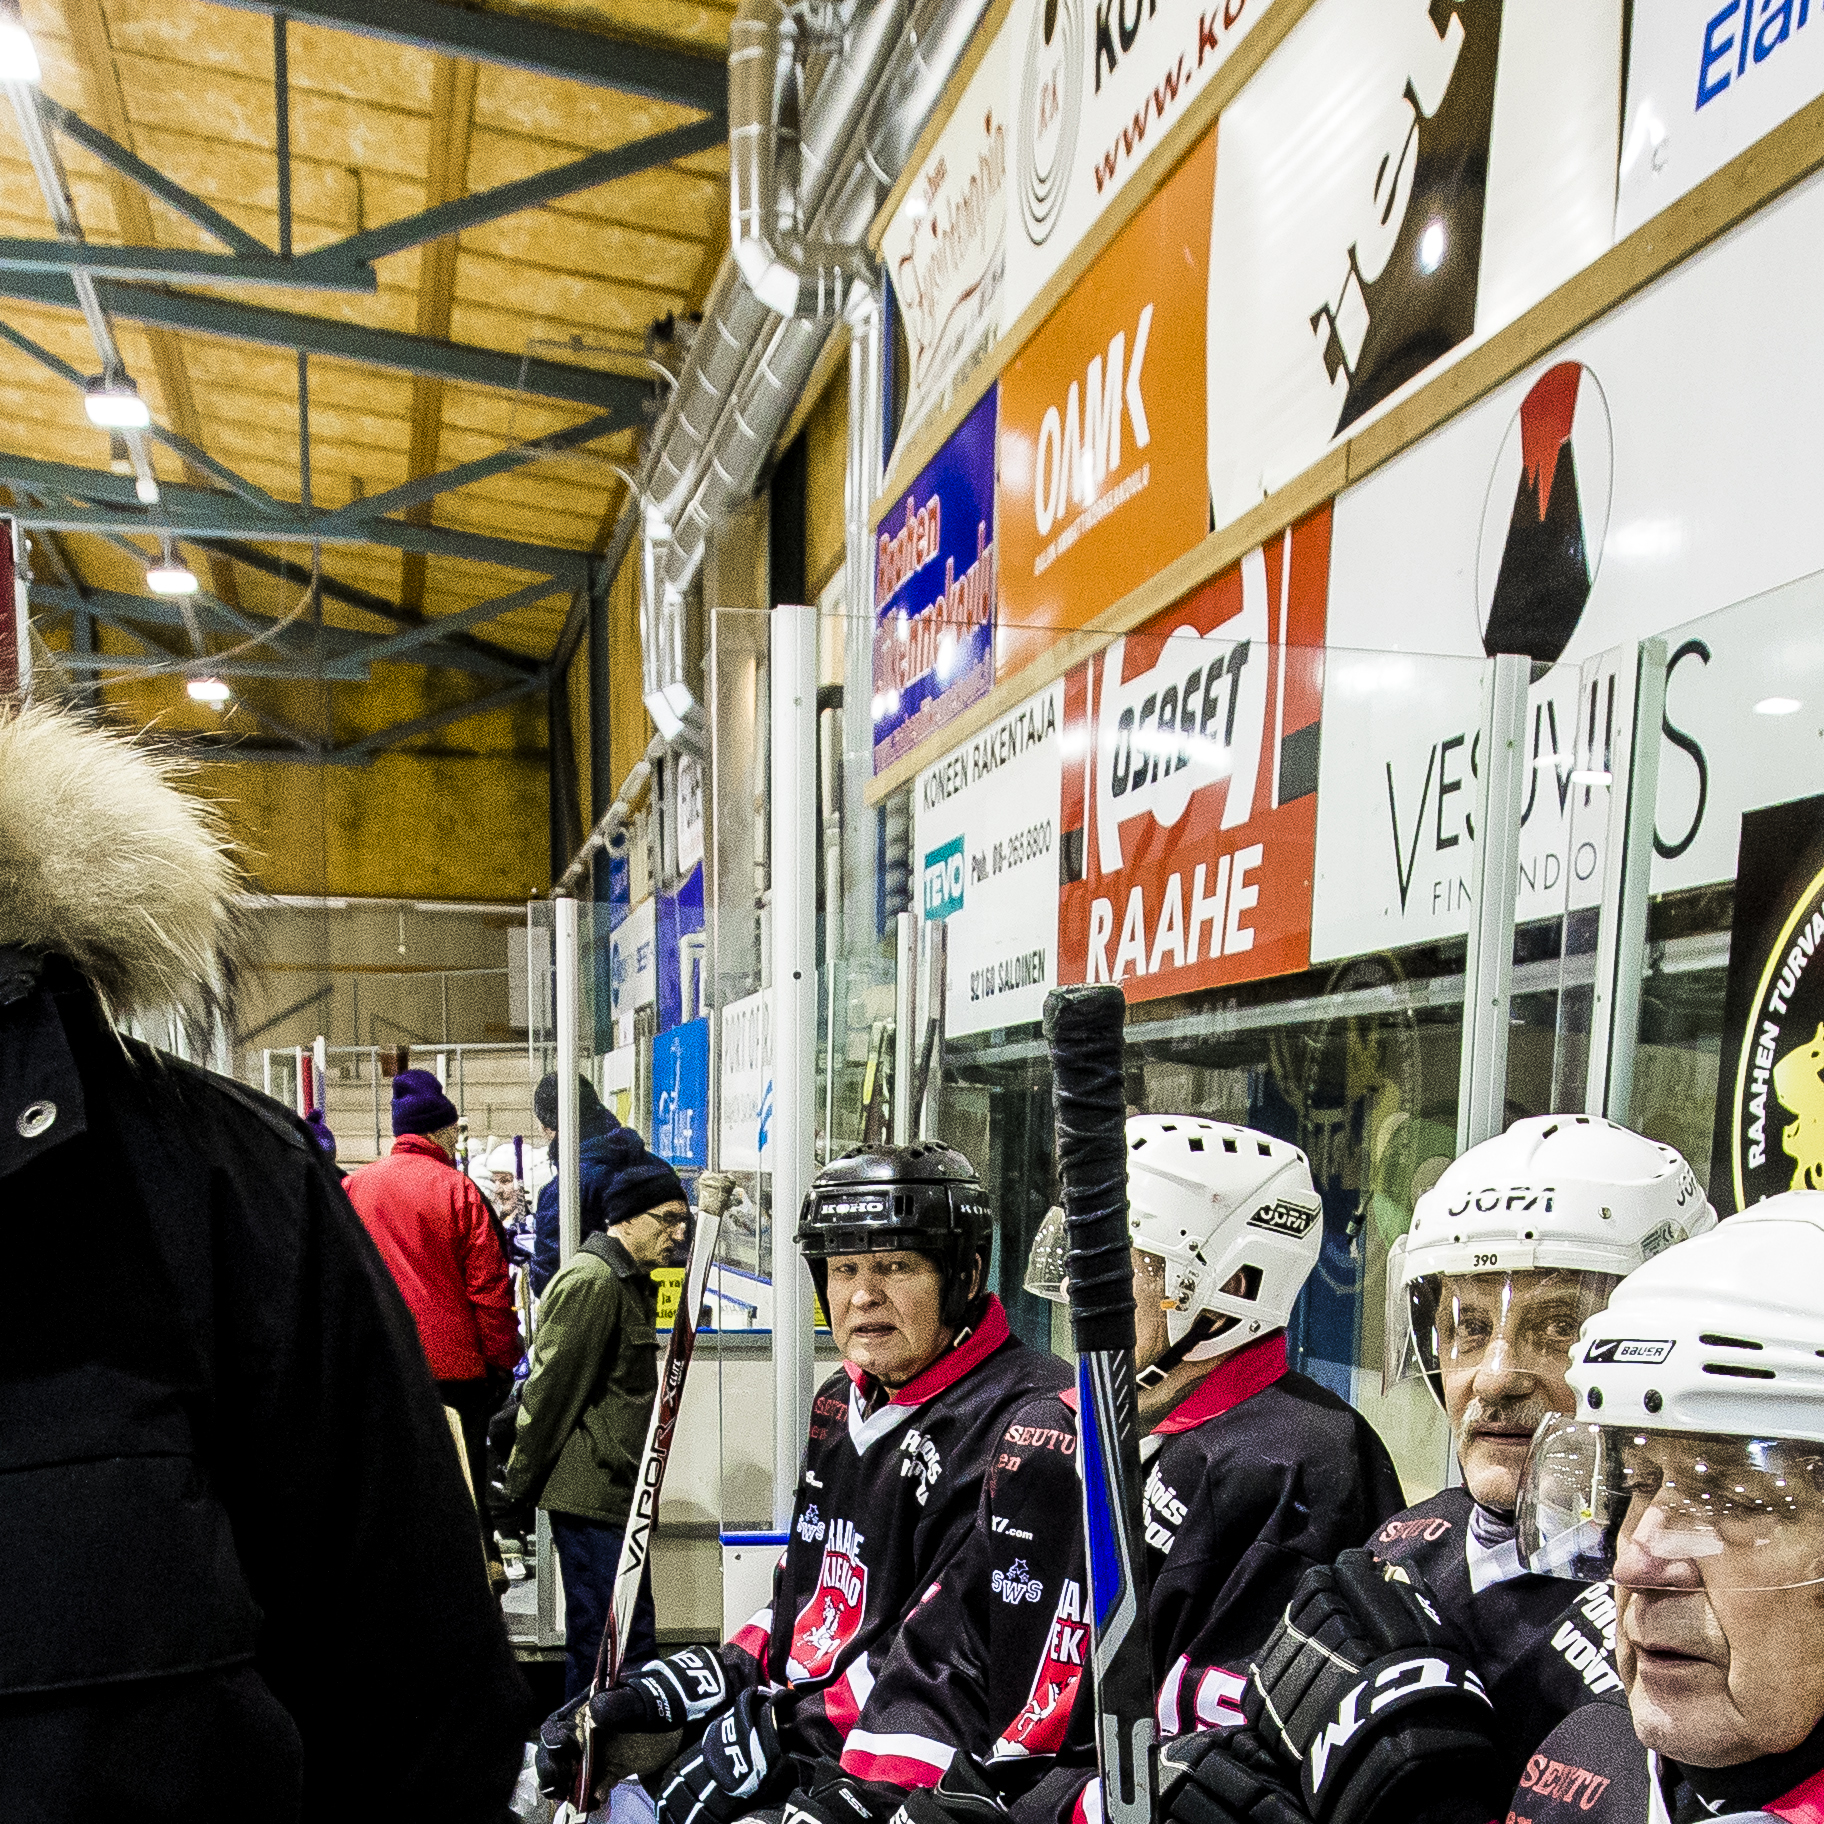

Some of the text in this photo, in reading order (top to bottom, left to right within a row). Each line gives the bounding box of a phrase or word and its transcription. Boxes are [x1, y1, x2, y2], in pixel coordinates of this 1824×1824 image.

[923, 748, 969, 813] KONEEN
[972, 692, 1057, 783] RAKENTAJA
[924, 851, 964, 911] TEVO
[1085, 841, 1265, 986] RAAHE
[997, 947, 1046, 993] SALOINEN
[1748, 1021, 1780, 1169] RAAHEN
[820, 1200, 886, 1215] KOHO
[1259, 1204, 1310, 1234] JOFA
[1448, 1186, 1556, 1217] JOFA
[1473, 1253, 1498, 1267] 390
[1620, 1345, 1665, 1357] BAUER
[991, 1569, 1044, 1605] SWS
